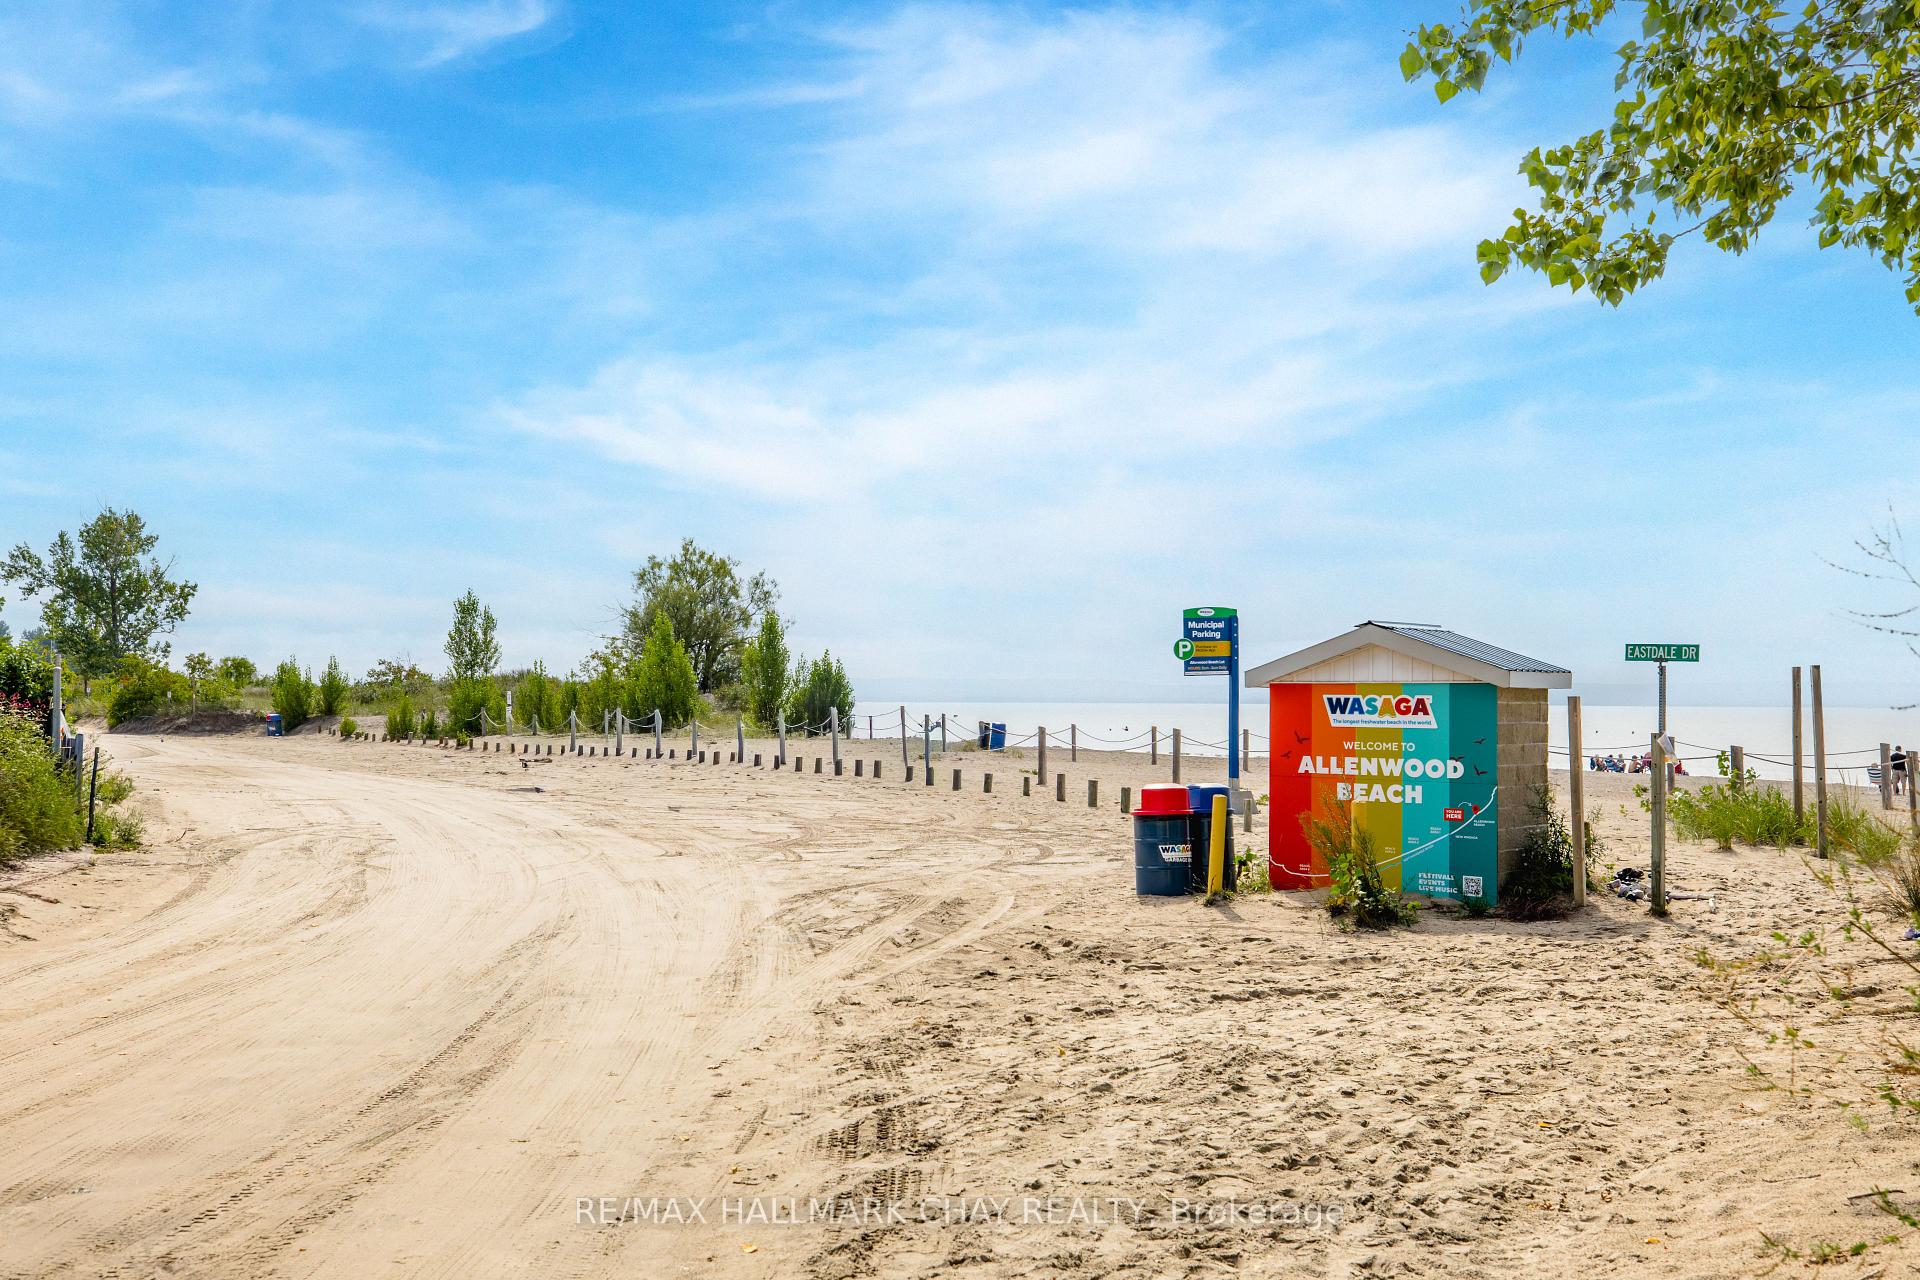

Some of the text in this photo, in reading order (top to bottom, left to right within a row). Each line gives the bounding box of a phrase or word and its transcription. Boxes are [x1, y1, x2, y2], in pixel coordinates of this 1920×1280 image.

[1188, 621, 1224, 629] Municipal
[1192, 630, 1220, 639] Parking
[1179, 641, 1191, 657] P
[1628, 646, 1696, 659] EASTDALE DR
[1327, 697, 1429, 717] WASAGA
[1343, 741, 1415, 752] WELCOME TO
[1298, 756, 1465, 779] ALLENWOOD
[1337, 782, 1423, 804] BEACH
